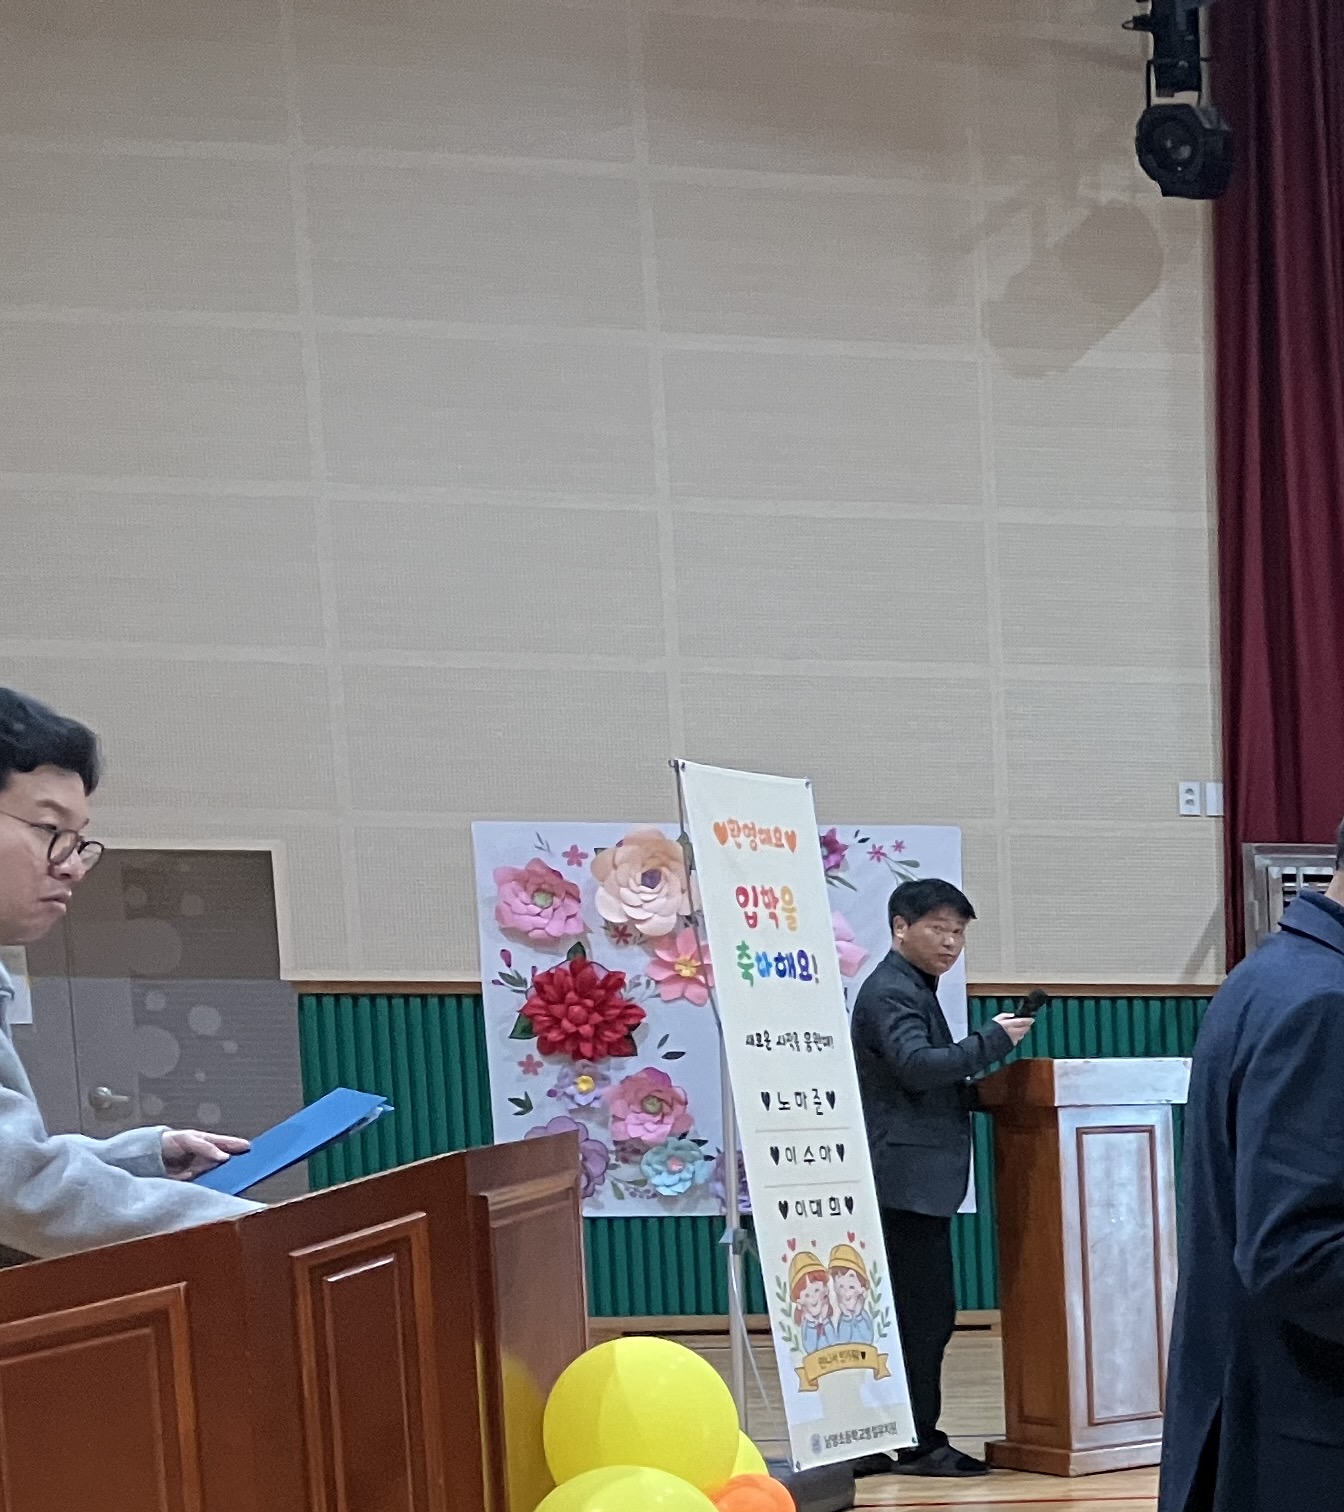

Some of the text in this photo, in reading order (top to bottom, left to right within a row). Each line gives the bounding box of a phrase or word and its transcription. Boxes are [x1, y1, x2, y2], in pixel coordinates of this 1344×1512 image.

[727, 817, 786, 852] 환영해요
[735, 884, 797, 932] 입학을
[736, 939, 819, 988] 축하해요!
[745, 1029, 772, 1052] 새로운
[776, 1031, 800, 1053] 시작을
[785, 1144, 832, 1166] 이수아
